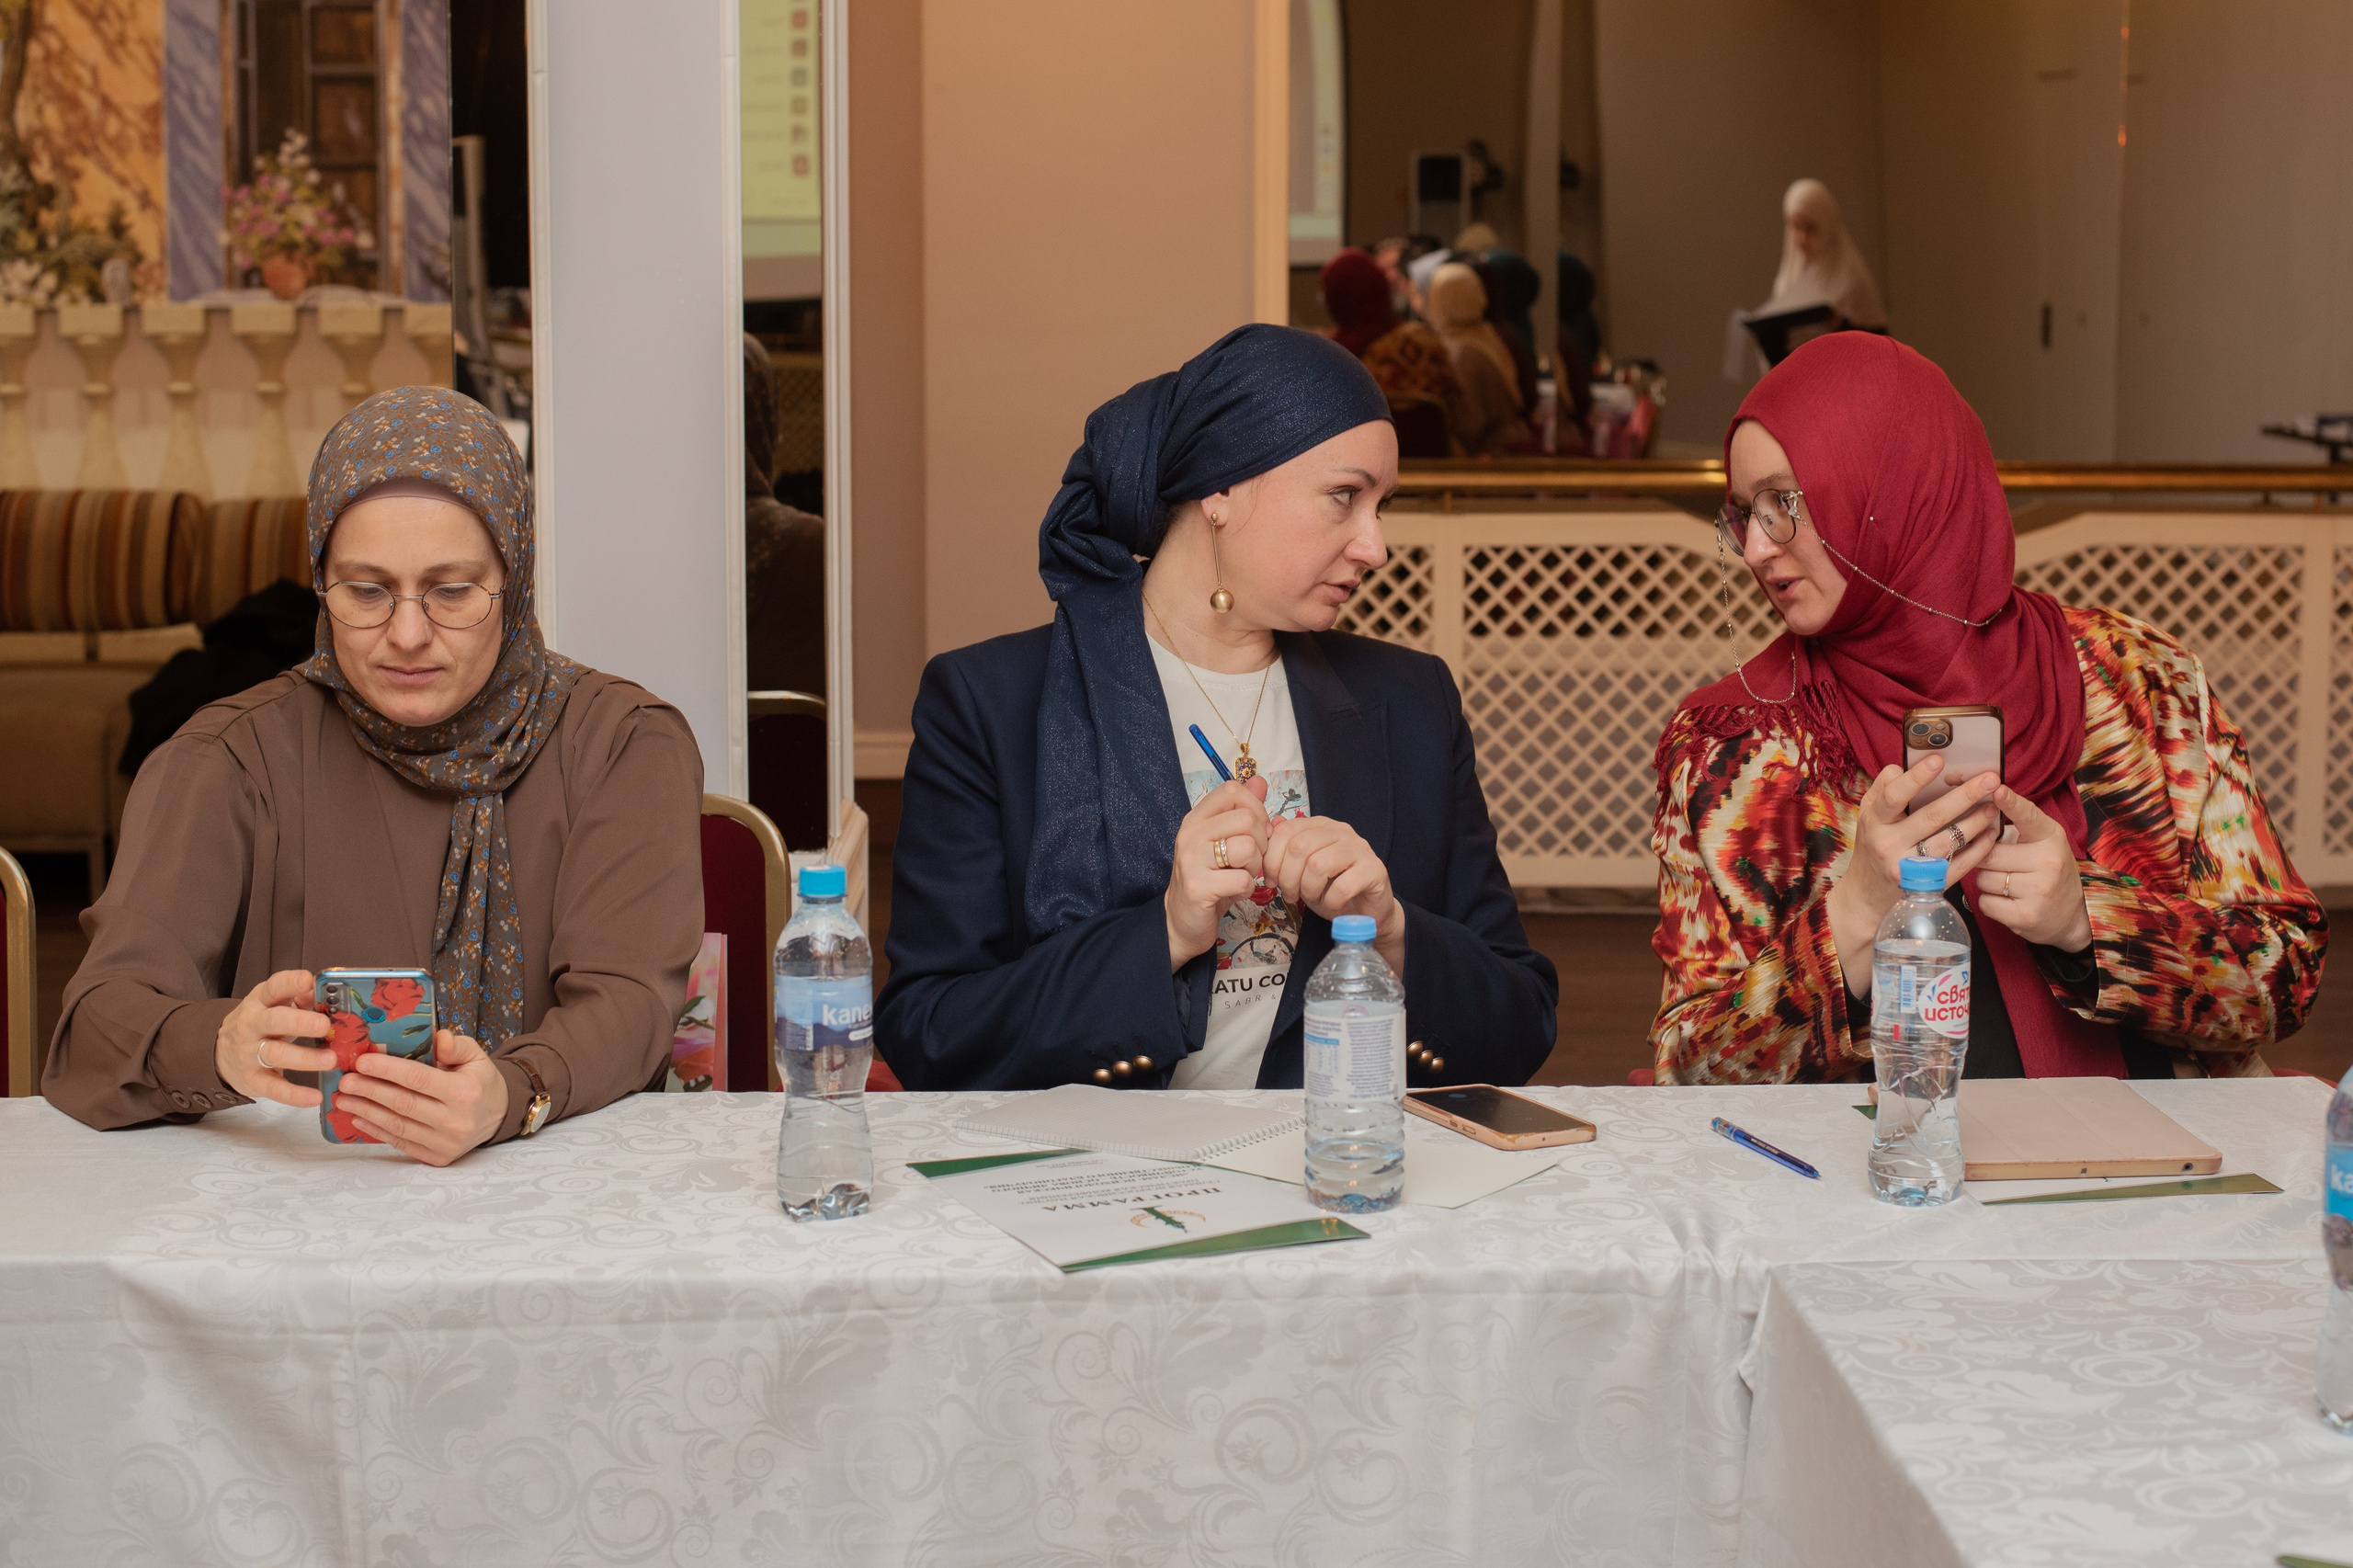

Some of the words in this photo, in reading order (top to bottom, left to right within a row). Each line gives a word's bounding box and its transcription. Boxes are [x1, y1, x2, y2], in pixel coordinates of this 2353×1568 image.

[1211, 978, 1253, 994] ATU
[1224, 994, 1261, 1009] SABR
[1040, 1187, 1222, 1211] ПРОГРАММА
